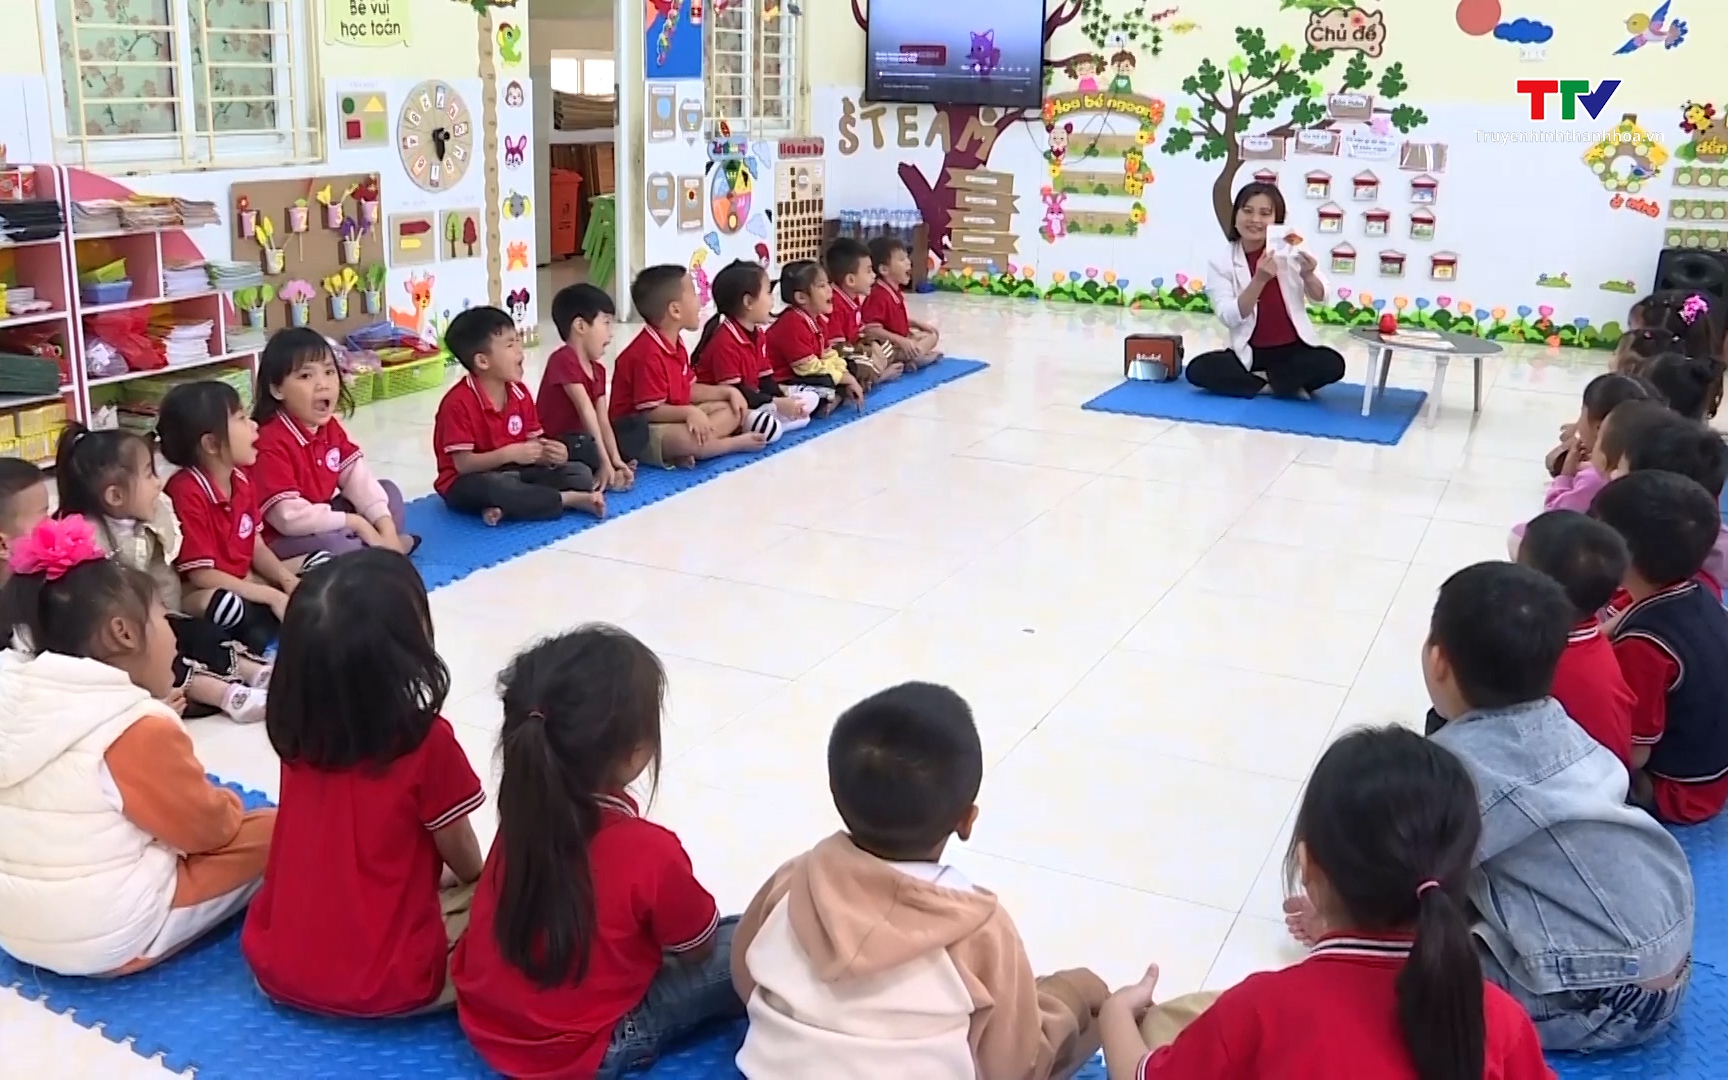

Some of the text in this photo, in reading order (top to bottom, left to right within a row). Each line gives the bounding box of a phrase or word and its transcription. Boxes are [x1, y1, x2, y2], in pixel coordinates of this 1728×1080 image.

[370, 0, 390, 15] vui
[340, 18, 401, 40] học toán
[1310, 23, 1347, 42] Chủ
[839, 105, 999, 161] STEAM
